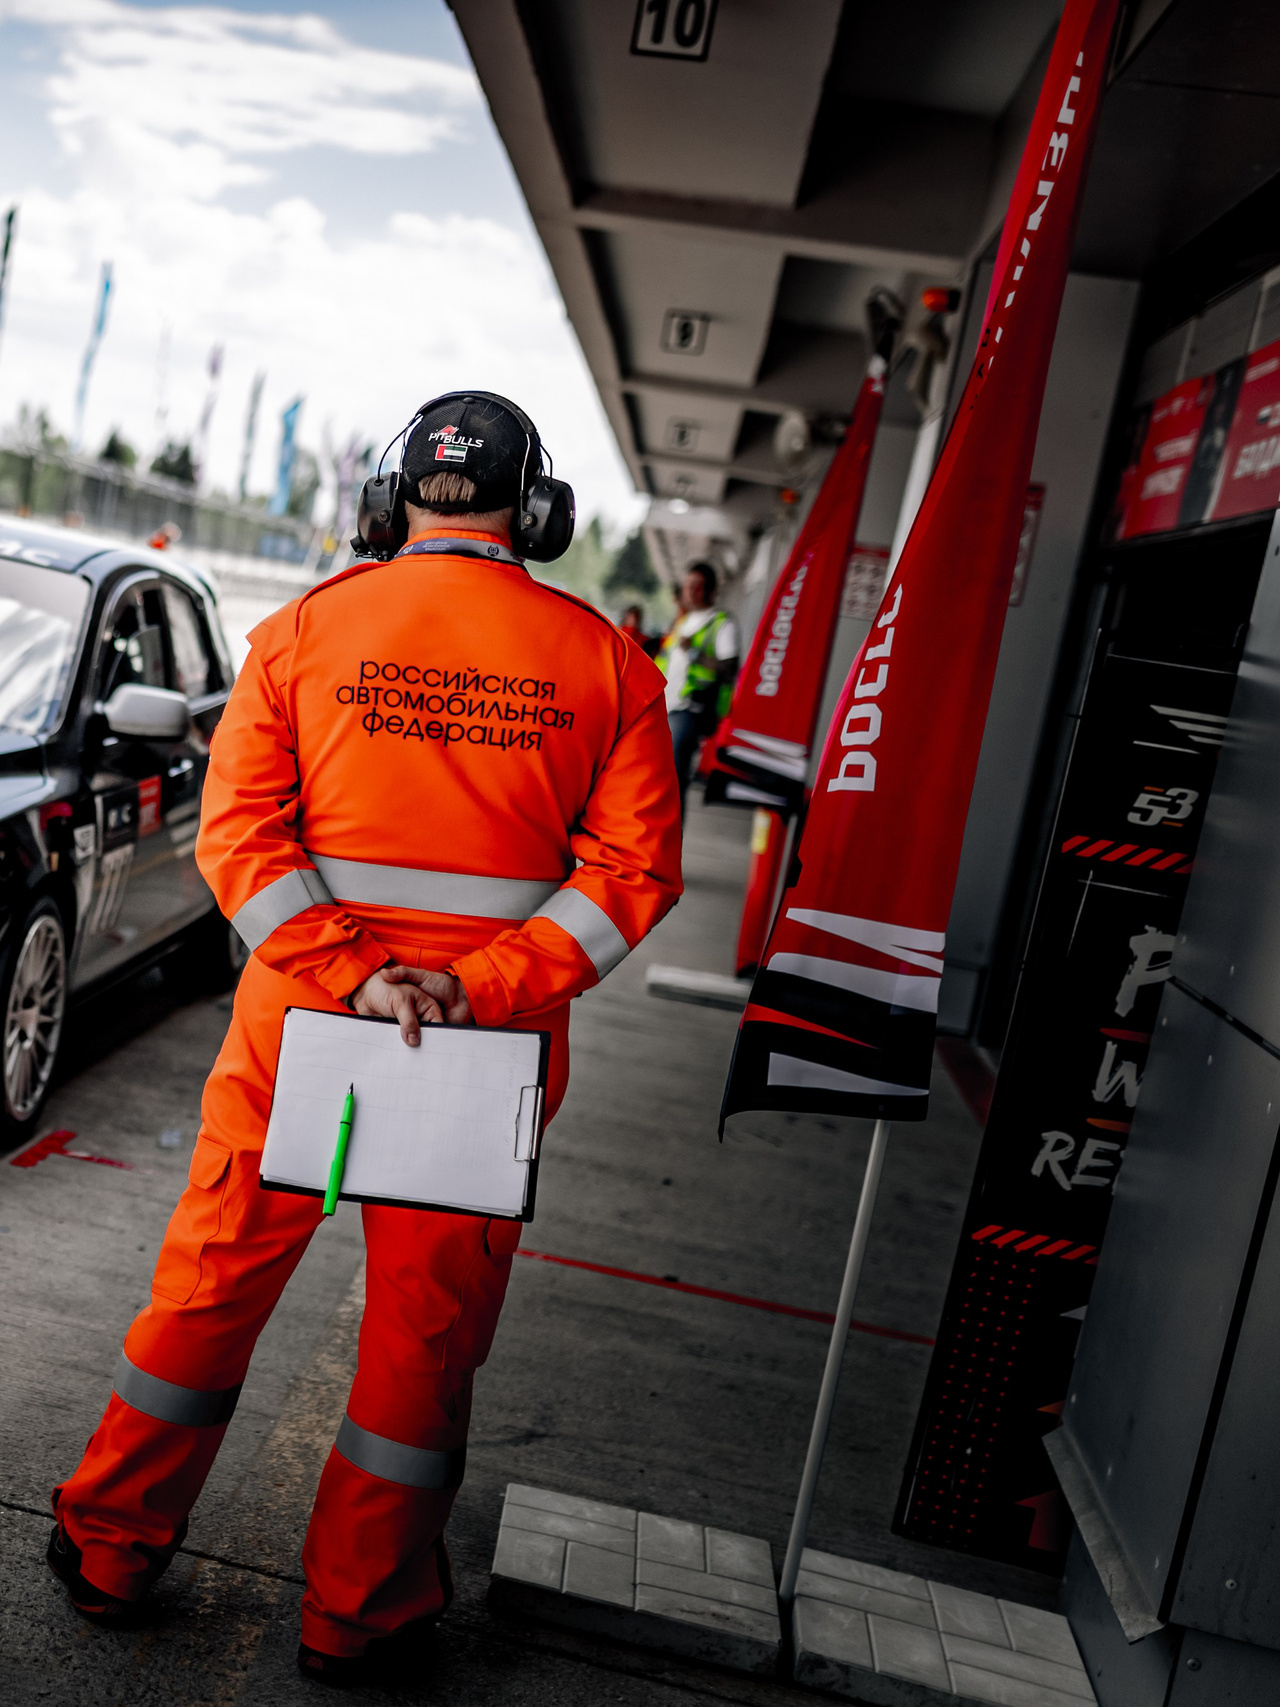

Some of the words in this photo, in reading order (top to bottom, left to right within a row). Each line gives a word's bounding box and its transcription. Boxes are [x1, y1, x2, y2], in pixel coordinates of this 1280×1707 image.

[647, 0, 706, 48] 10
[359, 660, 556, 701] российская
[335, 685, 575, 731] автомобильная
[361, 706, 543, 751] федерация
[1127, 787, 1199, 827] 53
[1031, 1130, 1125, 1196] RE
